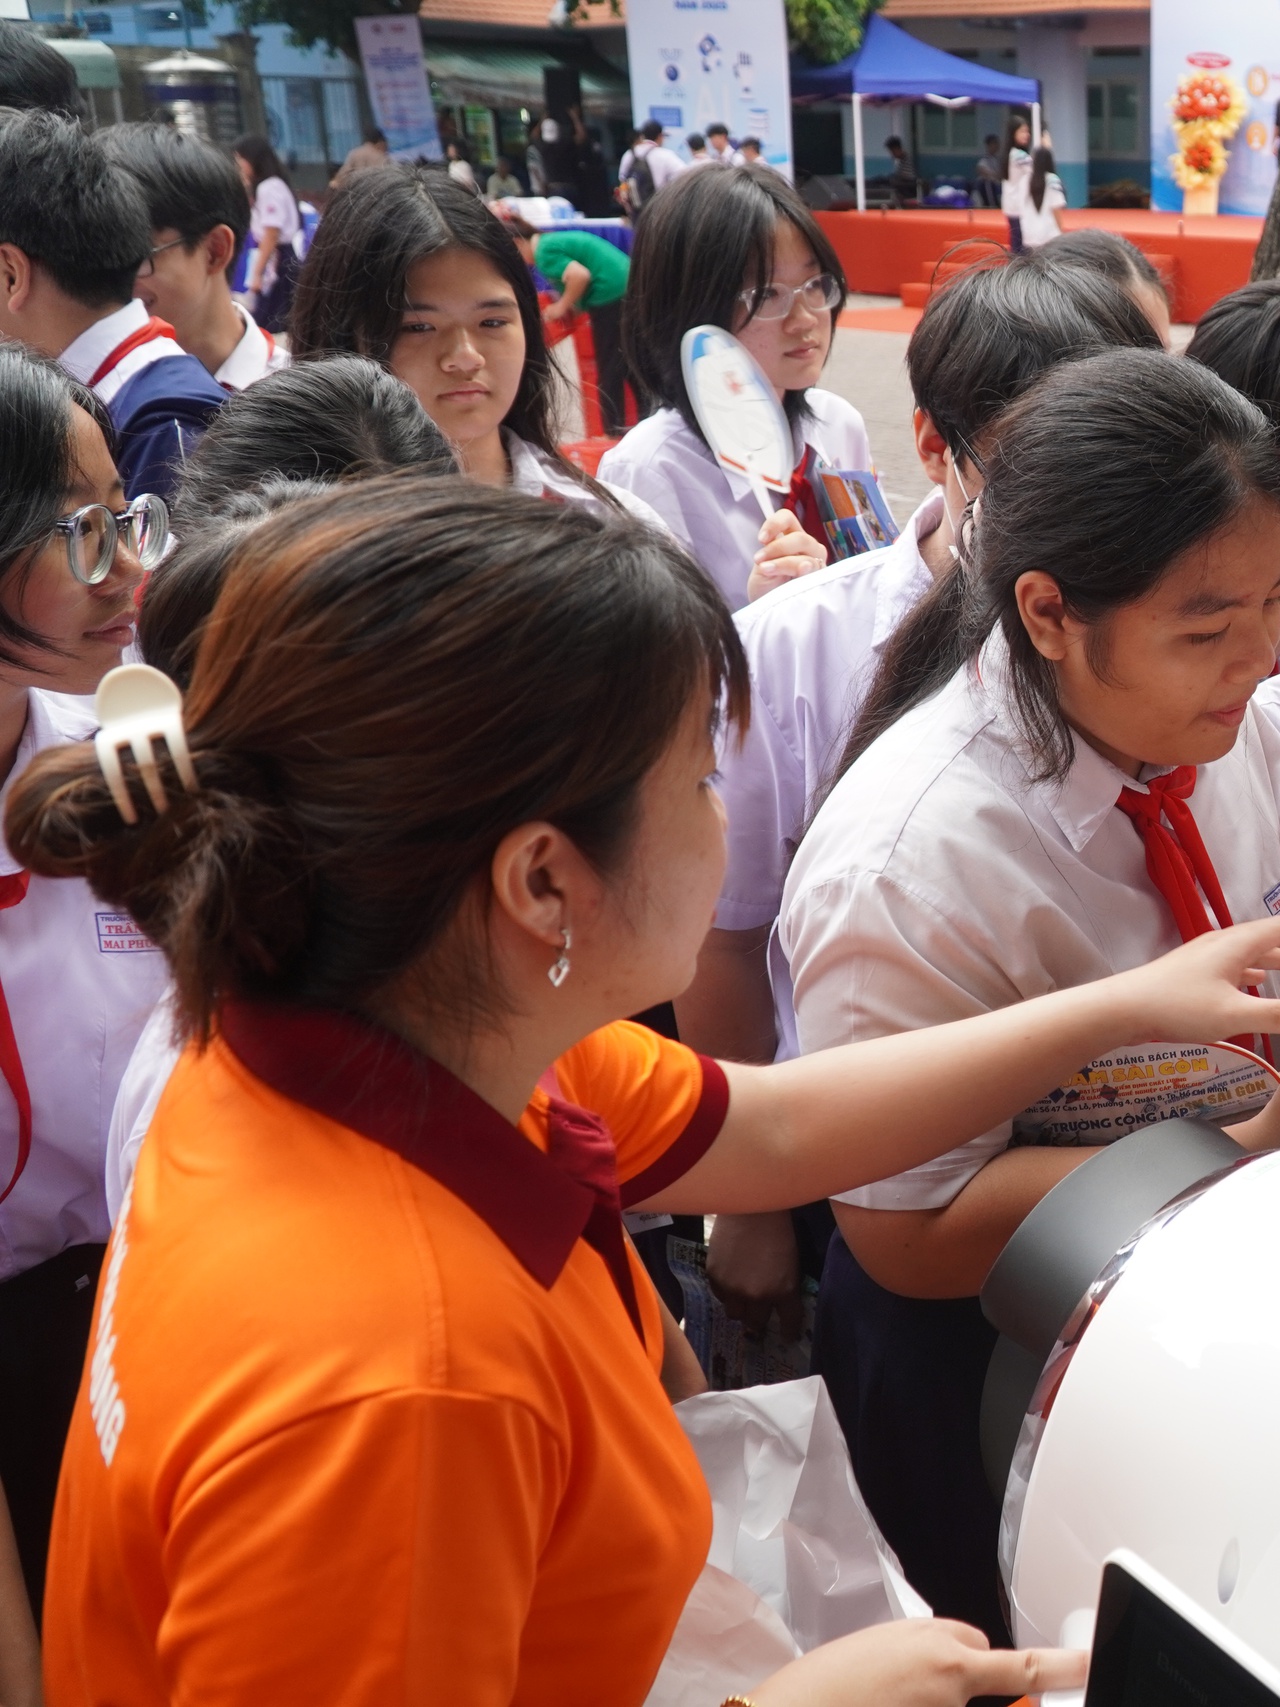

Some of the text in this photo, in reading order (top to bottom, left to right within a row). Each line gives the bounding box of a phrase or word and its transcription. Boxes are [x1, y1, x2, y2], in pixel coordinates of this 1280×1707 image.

[103, 940, 125, 949] MAI
[1091, 1047, 1209, 1069] CAO ĐẲNG BÁCH KHOA
[1111, 1064, 1155, 1083] SÀI
[1158, 1057, 1209, 1076] GÒN
[1062, 1104, 1078, 1112] Cao
[1092, 1098, 1124, 1109] Phường
[1134, 1096, 1156, 1104] Quận
[1052, 1118, 1112, 1133] TRƯỜNG
[1115, 1112, 1157, 1127] CÔNG
